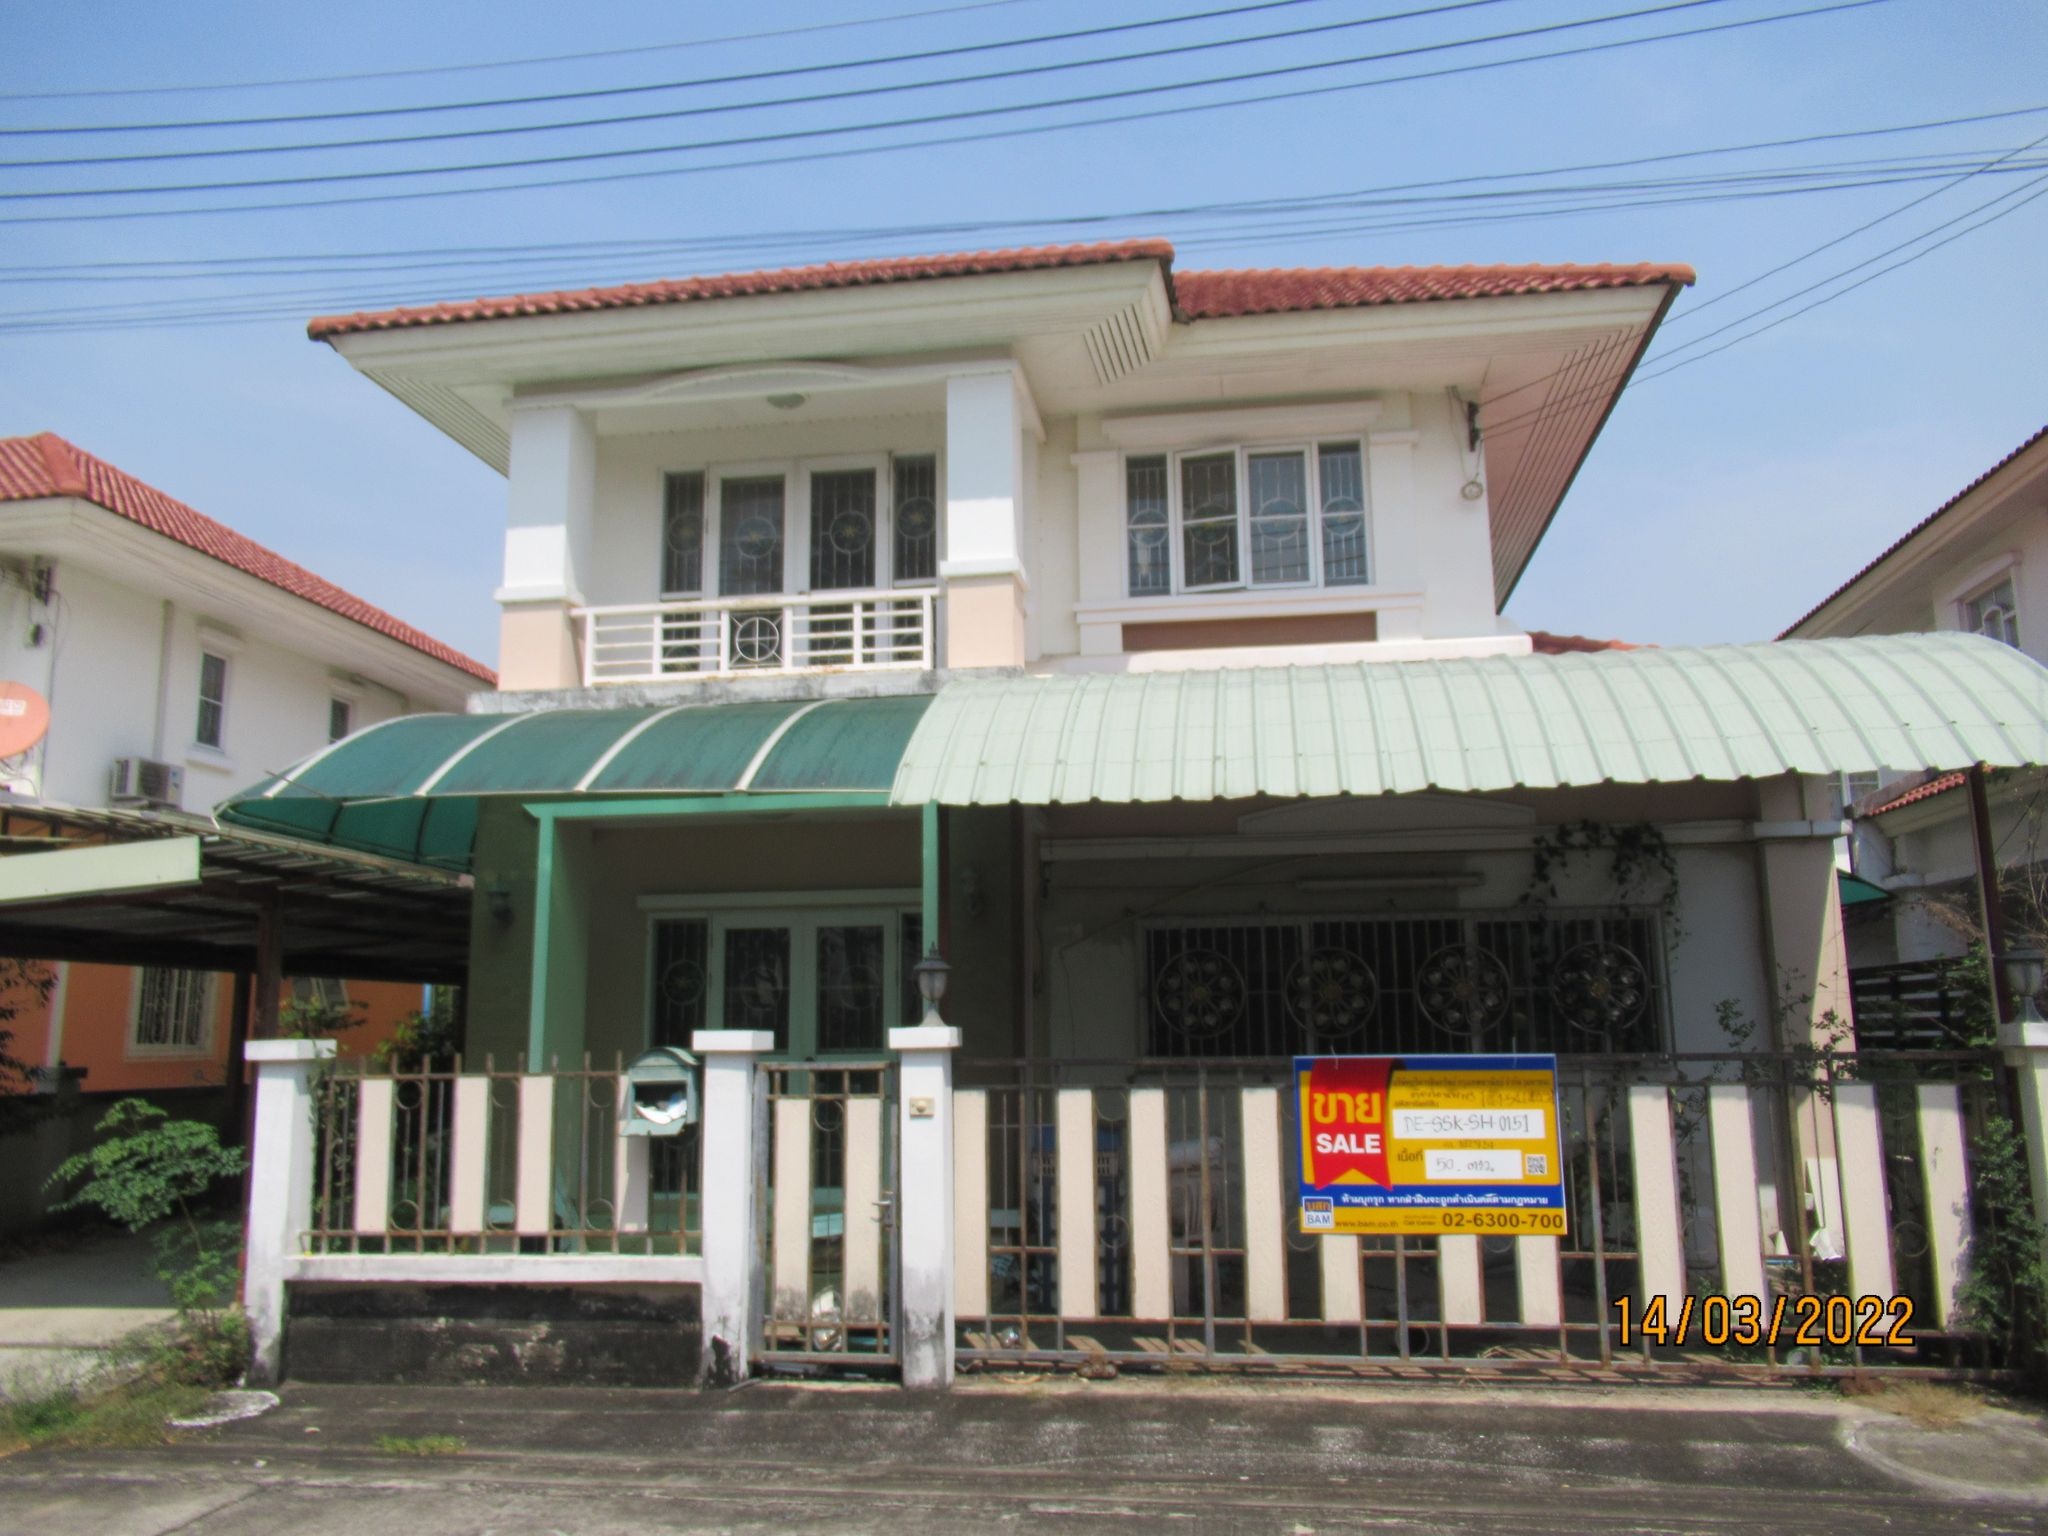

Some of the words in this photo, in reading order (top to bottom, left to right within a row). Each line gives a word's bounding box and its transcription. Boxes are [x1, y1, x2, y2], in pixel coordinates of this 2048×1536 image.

[1313, 1092, 1380, 1124] ขาย
[1316, 1133, 1382, 1155] SALE
[1307, 1214, 1331, 1225] BAM
[1442, 1212, 1563, 1228] 02-6300-700
